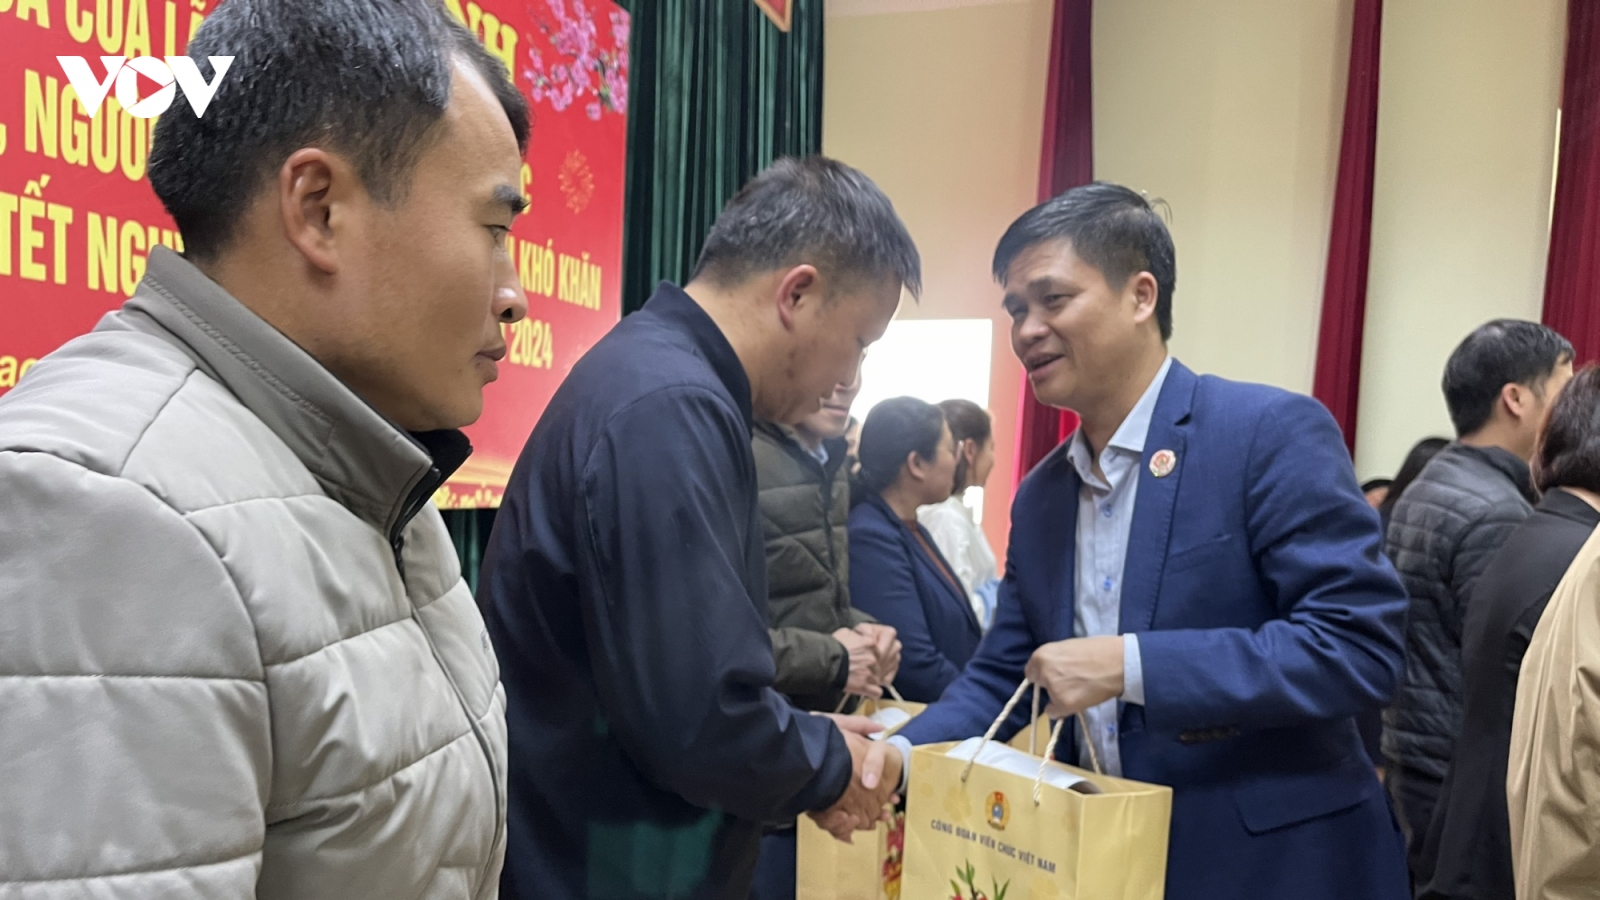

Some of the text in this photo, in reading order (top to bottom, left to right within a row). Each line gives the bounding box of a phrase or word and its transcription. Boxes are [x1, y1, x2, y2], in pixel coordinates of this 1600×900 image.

[0, 174, 73, 285] TẾT
[519, 238, 555, 297] KHÓ
[558, 251, 601, 311] KHĂN
[509, 317, 553, 369] 2024
[1037, 857, 1056, 873] NAM
